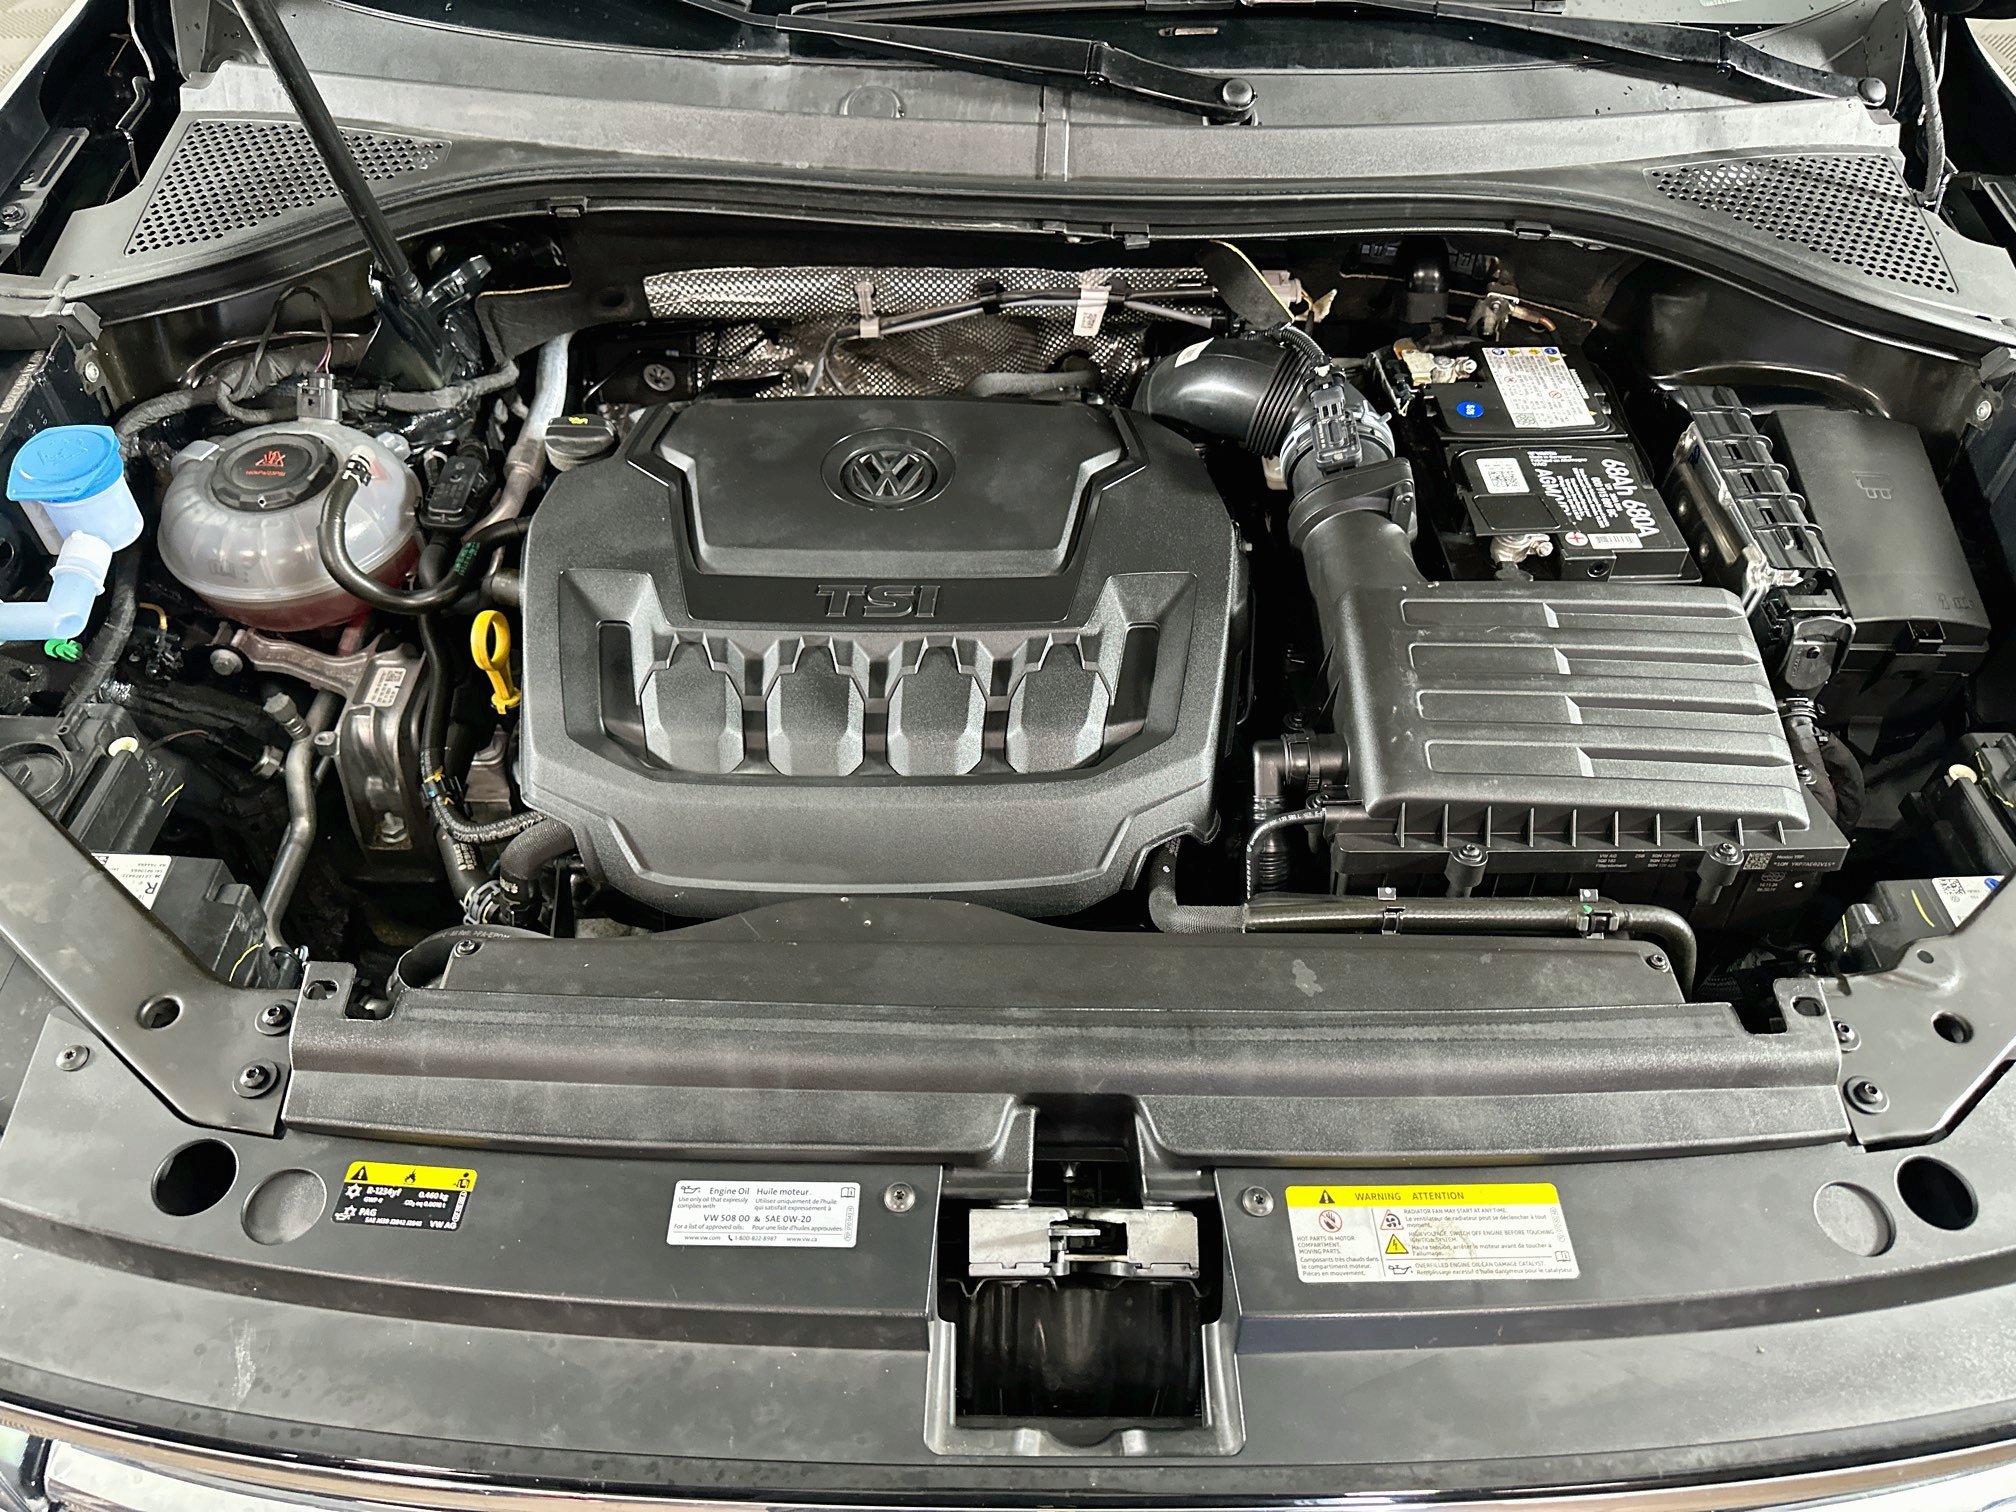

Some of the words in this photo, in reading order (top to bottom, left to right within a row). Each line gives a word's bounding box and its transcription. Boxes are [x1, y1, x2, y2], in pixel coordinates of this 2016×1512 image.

[848, 449, 930, 499] VW
[1602, 458, 1637, 496] 68Ah
[1622, 500, 1660, 538] 680A
[816, 585, 940, 618] TSI
[145, 882, 158, 894] R
[366, 1186, 402, 1198] R-1234yf
[440, 1192, 449, 1202] kg
[710, 1187, 736, 1196] Engine
[1354, 1192, 1401, 1201] WARNING
[1412, 1192, 1464, 1200] ATTENTION
[358, 1208, 377, 1216] PAG
[430, 1220, 444, 1228] VW
[444, 1222, 457, 1230] AG
